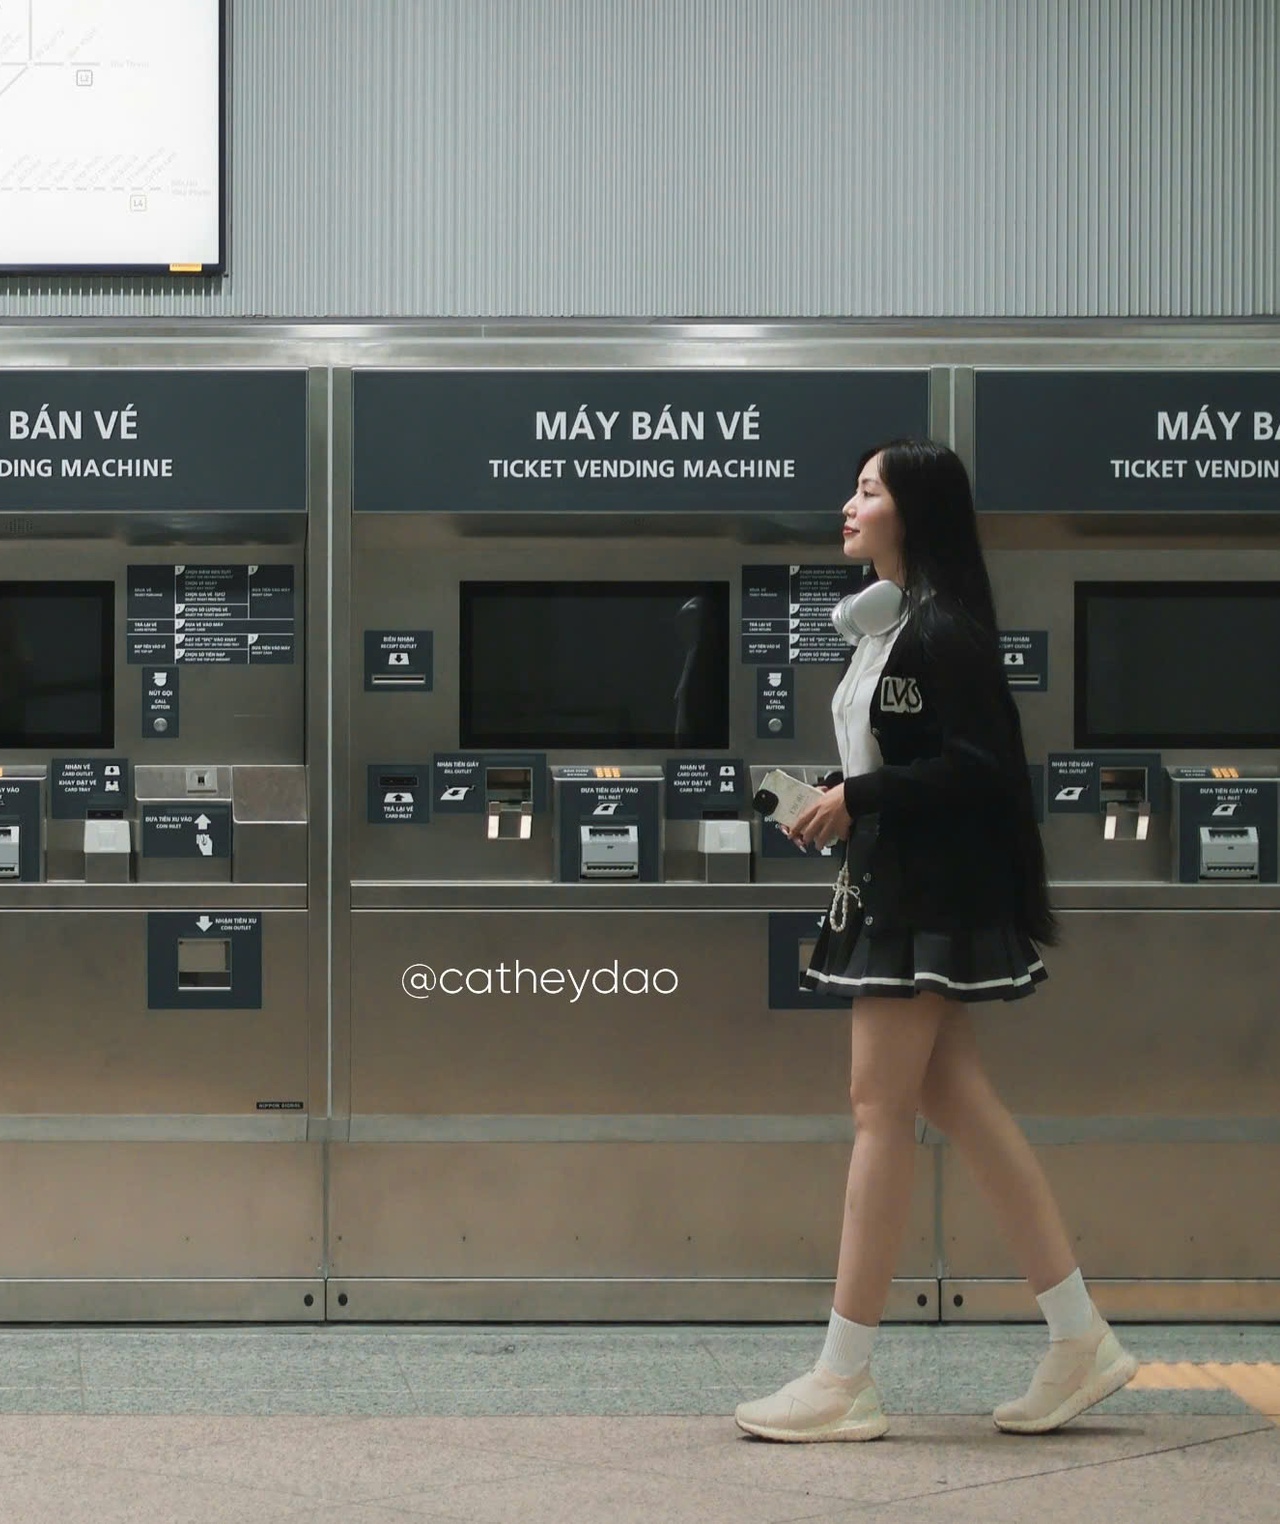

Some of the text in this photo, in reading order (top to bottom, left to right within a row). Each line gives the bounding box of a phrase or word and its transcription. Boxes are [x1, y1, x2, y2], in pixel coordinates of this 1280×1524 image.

[10, 404, 82, 439] BÁN
[94, 404, 137, 439] VÉ
[536, 404, 760, 440] MÁY BÁN VÉ
[1157, 405, 1241, 440] MÁY
[61, 459, 173, 477] MACHINE
[489, 459, 795, 478] TICKET VENDING MACHINE
[1110, 460, 1279, 478] TICKET VENDIN
